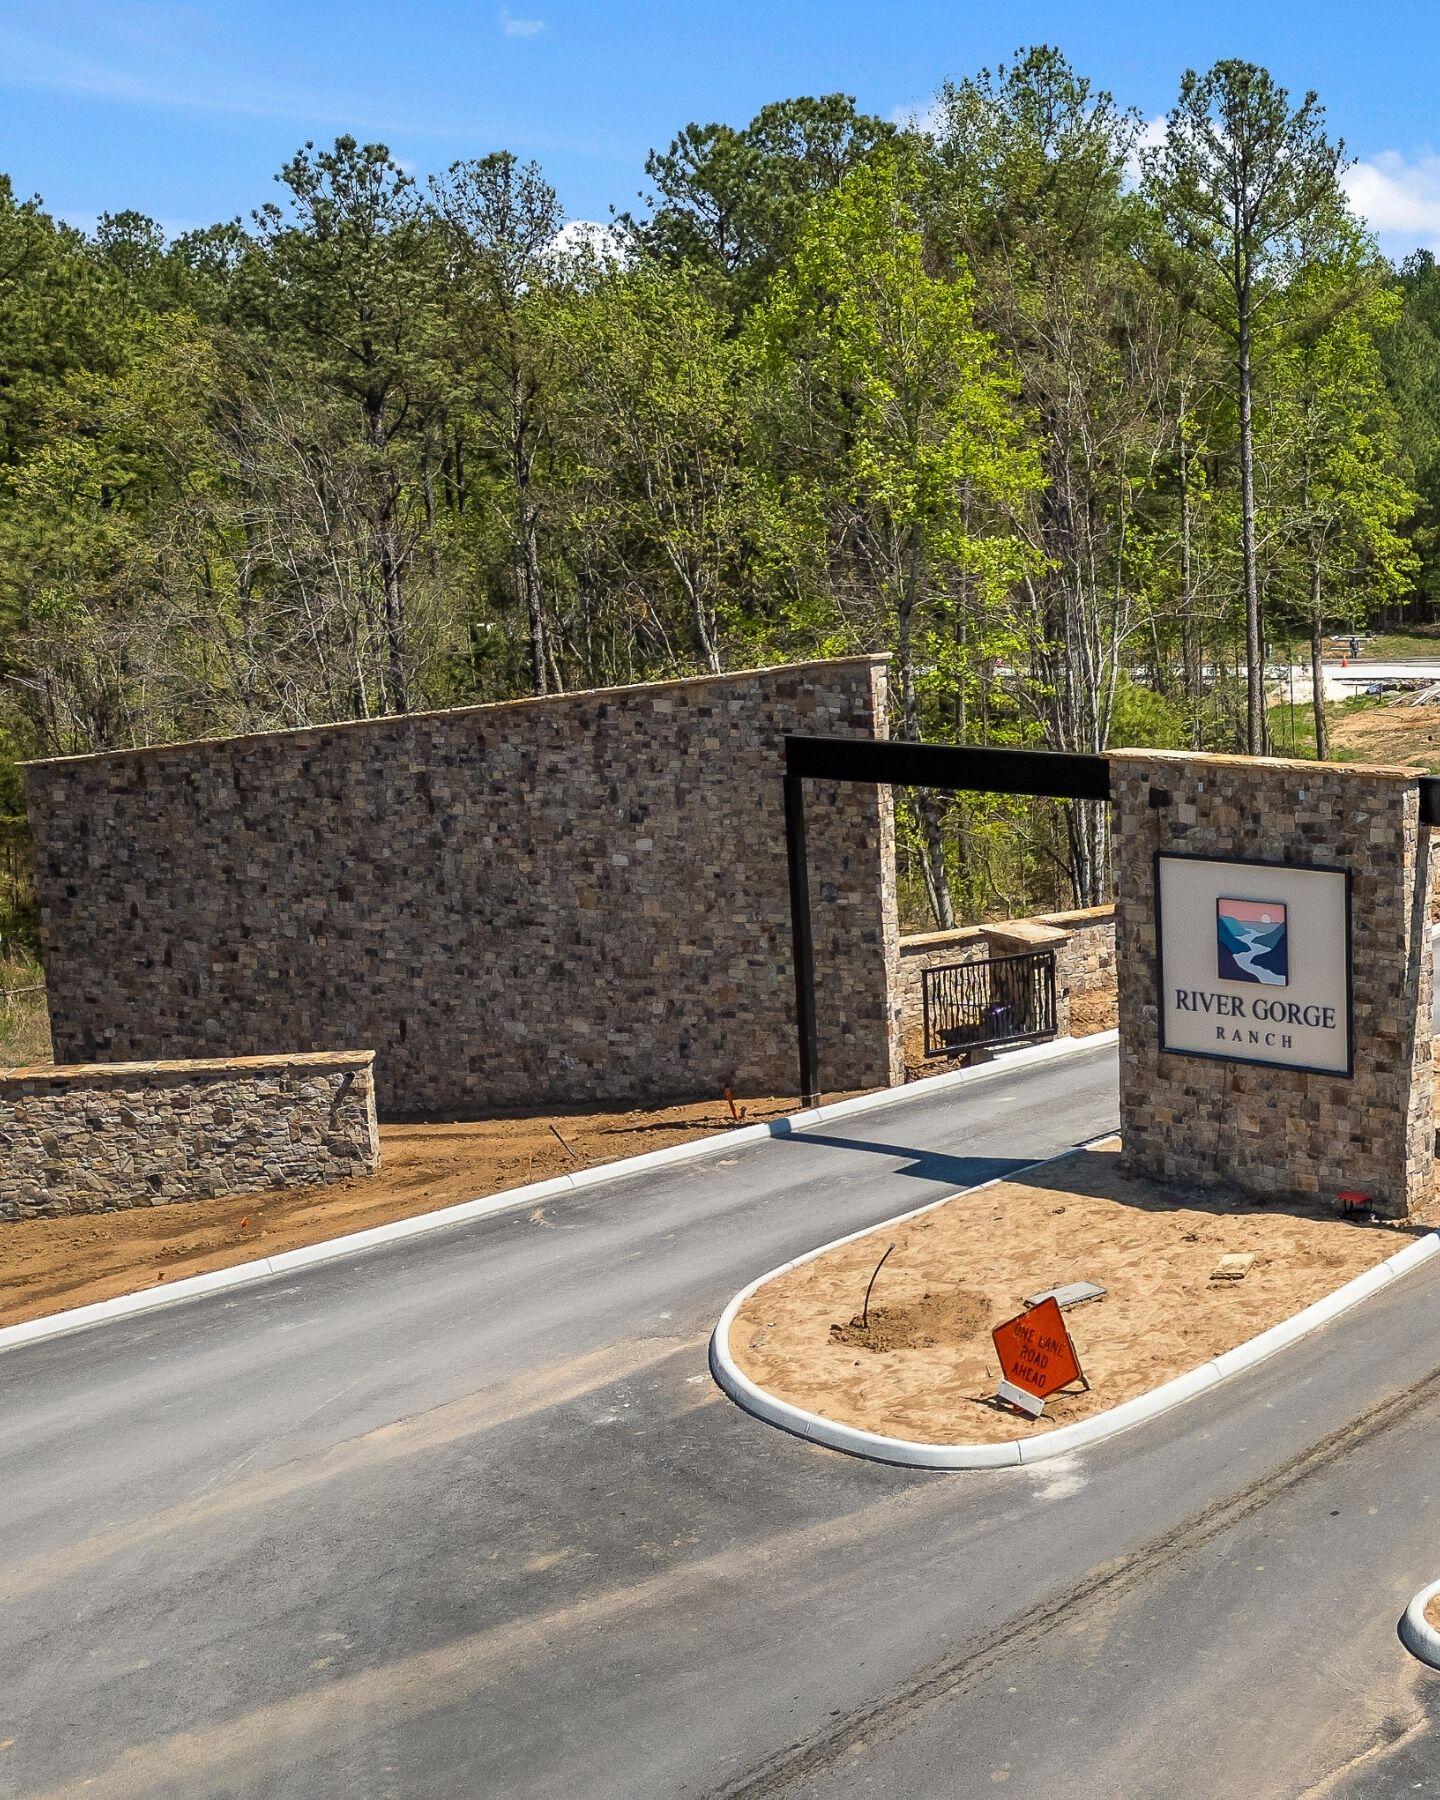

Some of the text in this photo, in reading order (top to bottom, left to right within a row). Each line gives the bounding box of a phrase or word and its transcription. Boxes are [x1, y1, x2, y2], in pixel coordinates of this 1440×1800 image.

[1175, 990, 1336, 1028] RIVER GORGE
[1216, 1026, 1293, 1048] RANCH
[1014, 1324, 1065, 1358] ONE LANE
[1020, 1345, 1047, 1369] ROAD
[1012, 1362, 1046, 1388] AHEAD
